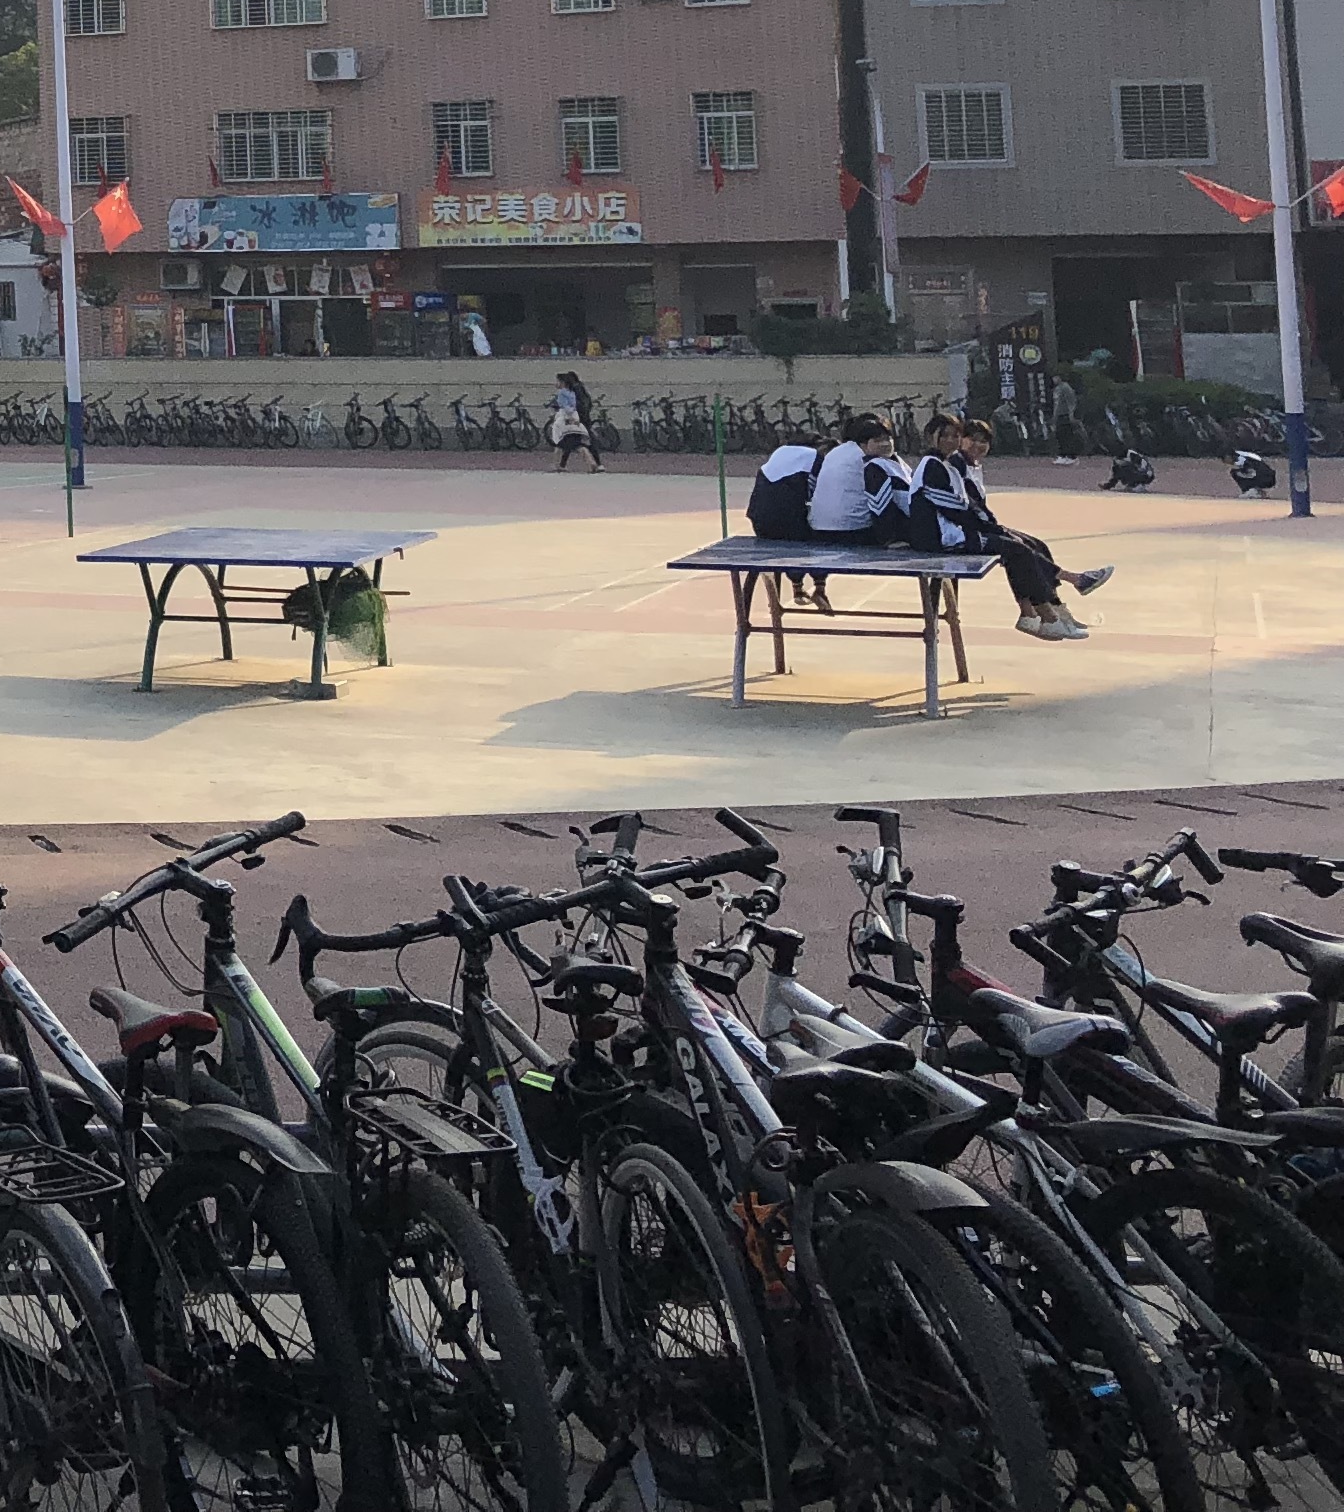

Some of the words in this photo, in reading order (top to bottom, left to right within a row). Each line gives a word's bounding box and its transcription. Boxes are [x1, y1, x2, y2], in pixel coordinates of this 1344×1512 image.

[432, 191, 627, 224] 荣记美食小店
[1009, 325, 1039, 340] 119
